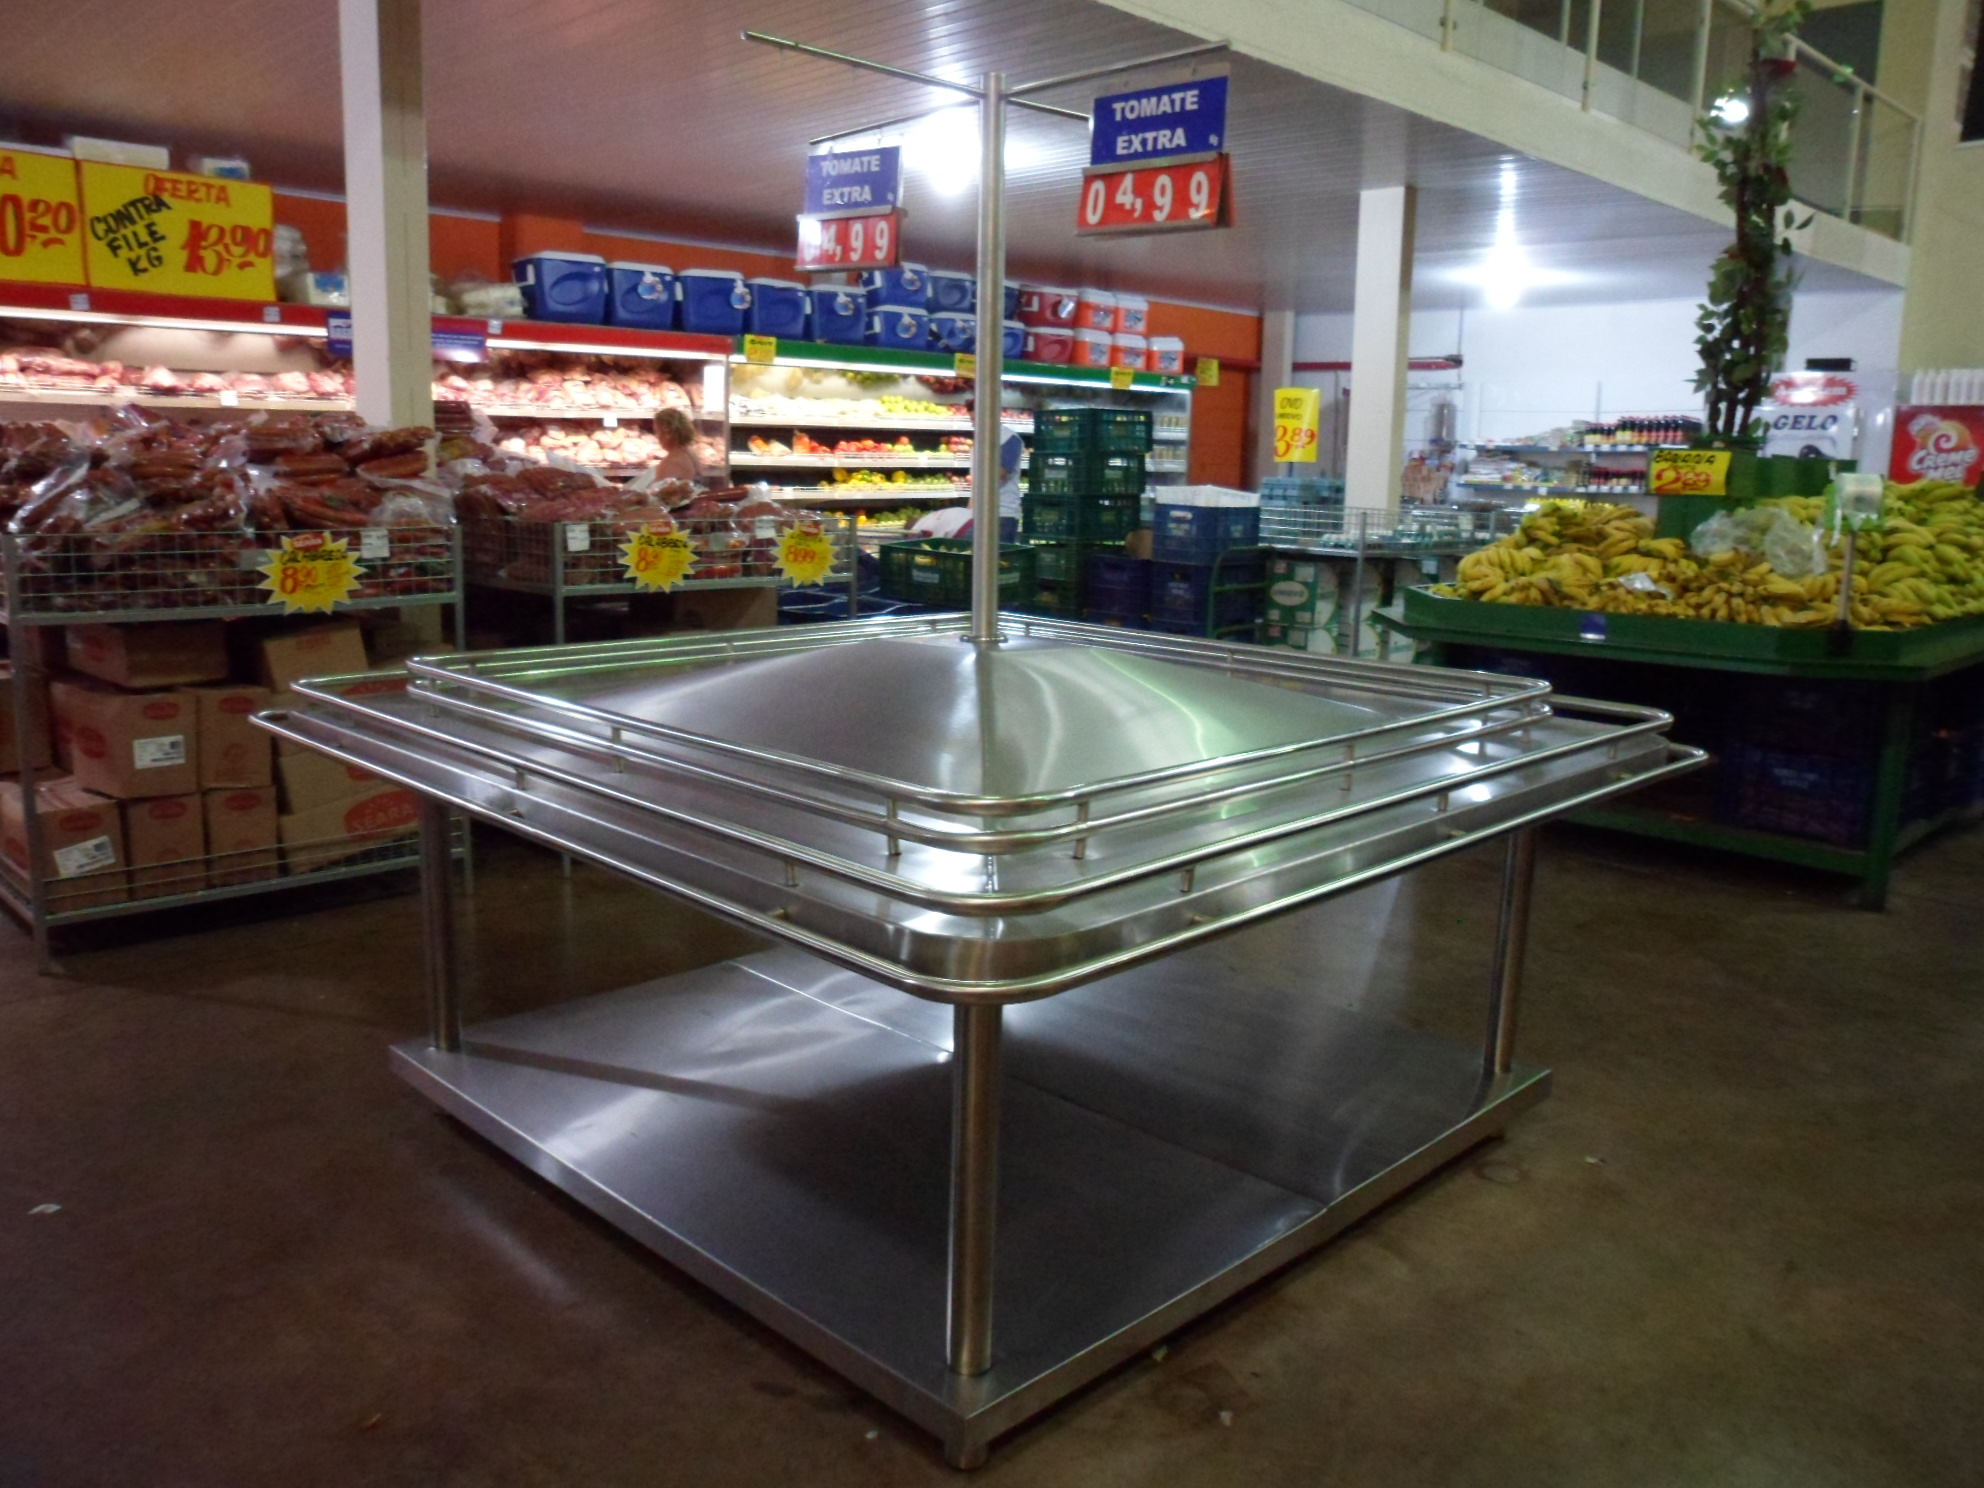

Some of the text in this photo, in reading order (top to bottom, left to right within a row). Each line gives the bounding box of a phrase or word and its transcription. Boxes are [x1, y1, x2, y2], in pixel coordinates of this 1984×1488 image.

[1112, 89, 1200, 121] TOMATE
[1116, 128, 1187, 155] EXTRA
[820, 155, 881, 177] TOMATE
[144, 173, 231, 207] OFERTA
[823, 185, 872, 205] EXTRA
[90, 194, 172, 241] CONTRA
[106, 222, 167, 258] FILE
[127, 247, 163, 276] KG
[1773, 415, 1838, 430] GELO
